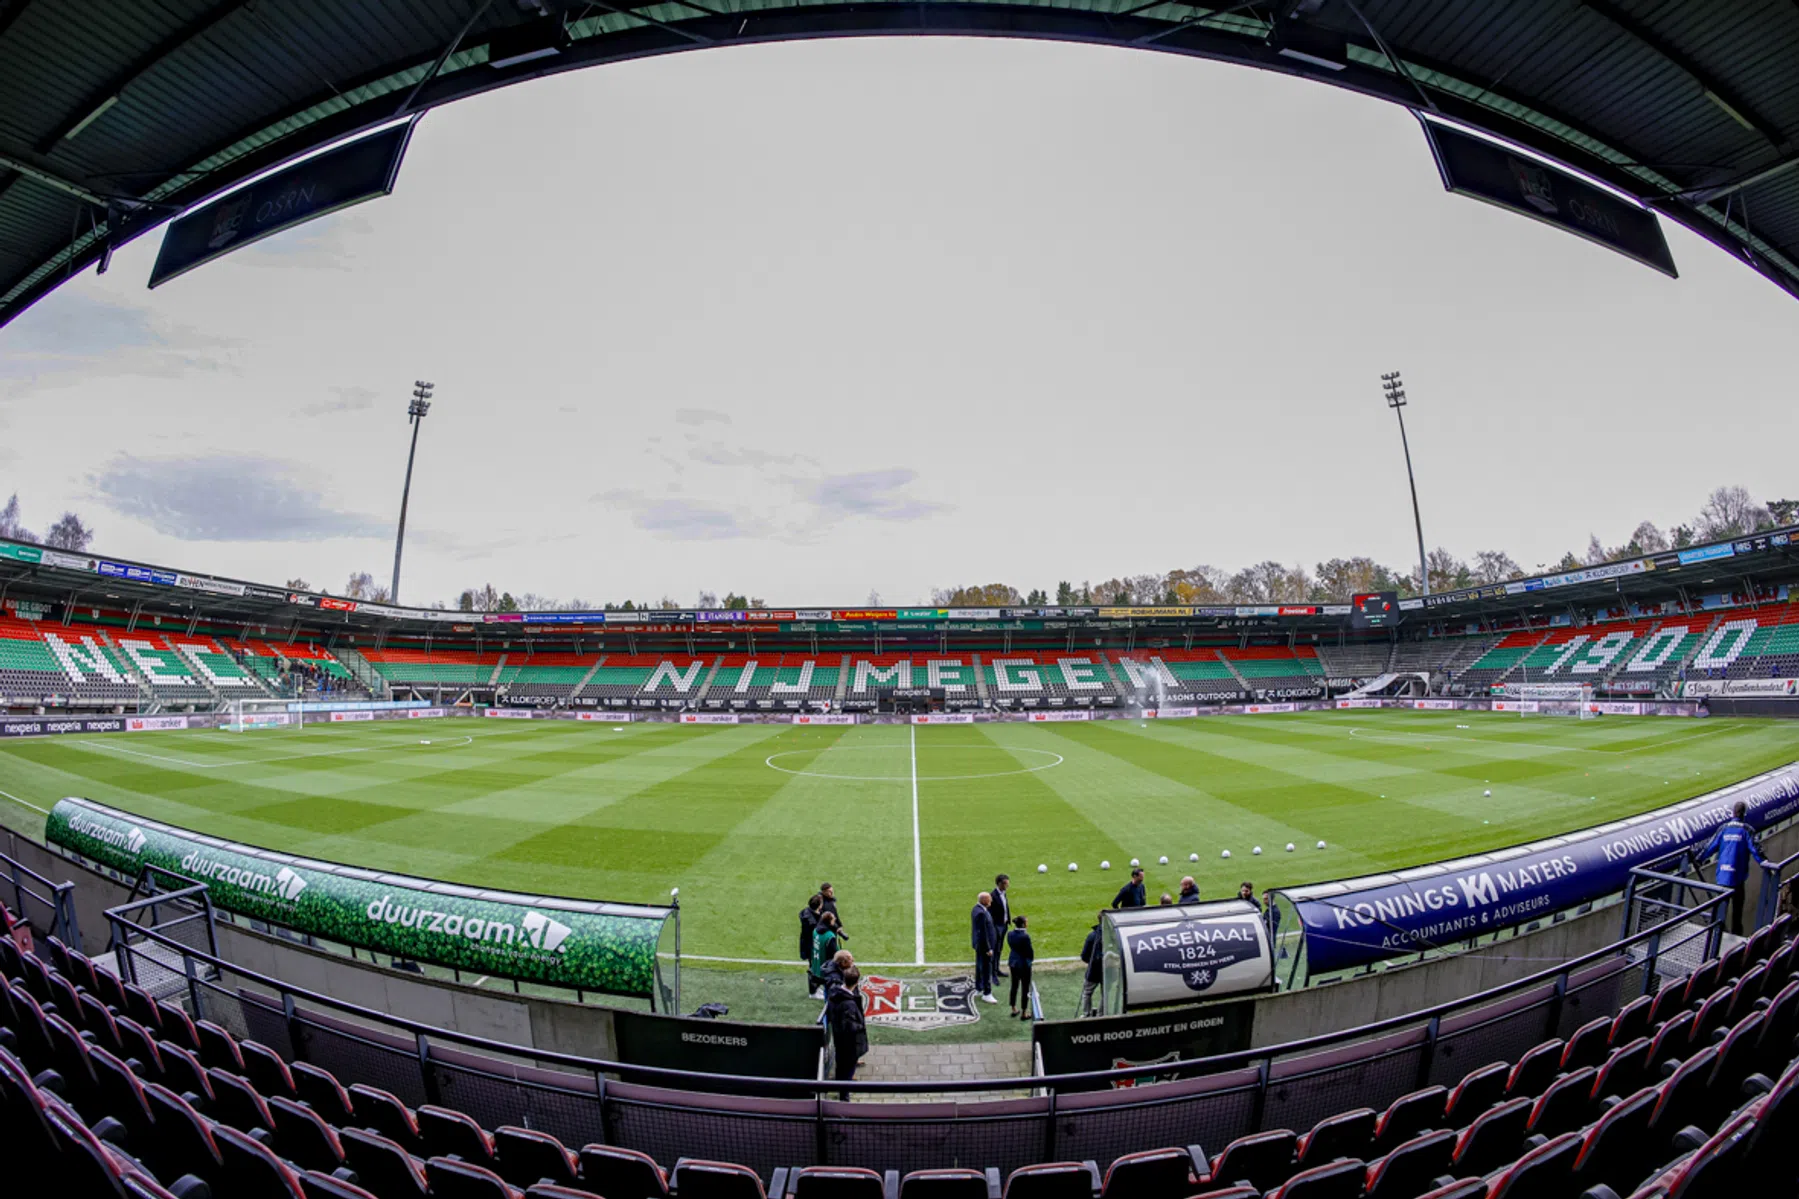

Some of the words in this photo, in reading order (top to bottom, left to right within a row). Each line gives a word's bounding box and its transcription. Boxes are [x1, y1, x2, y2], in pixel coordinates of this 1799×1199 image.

[1544, 619, 1758, 675] 1900
[44, 632, 255, 686] NEC
[510, 696, 556, 704] KLOKGROEP
[893, 689, 931, 697] nexperia
[1196, 692, 1237, 701] OUTDOOR
[845, 700, 876, 708] nexperia
[947, 699, 978, 708] nexperia
[5, 723, 40, 735] nexperia
[47, 721, 81, 733] nexperia
[87, 720, 120, 732] nexperia
[1601, 827, 1671, 862] KONINGS
[1688, 804, 1734, 833] MATERS
[1333, 885, 1459, 930] KONINGS
[1496, 855, 1577, 893] MATERS
[1381, 914, 1476, 949] ACCOUNTANTS
[1481, 912, 1489, 923] &
[1493, 894, 1551, 920] ADVISEURS
[1136, 928, 1254, 955] ARSENAAL
[1178, 945, 1217, 960] 1824
[873, 995, 967, 1011] NEC
[1071, 1034, 1102, 1044] VOOR
[1103, 1030, 1133, 1041] ROOD
[1135, 1025, 1172, 1038] ZWART
[1174, 1022, 1188, 1032] EN
[1190, 1016, 1225, 1030] GROEN
[681, 1032, 748, 1046] BEZOEKERS
